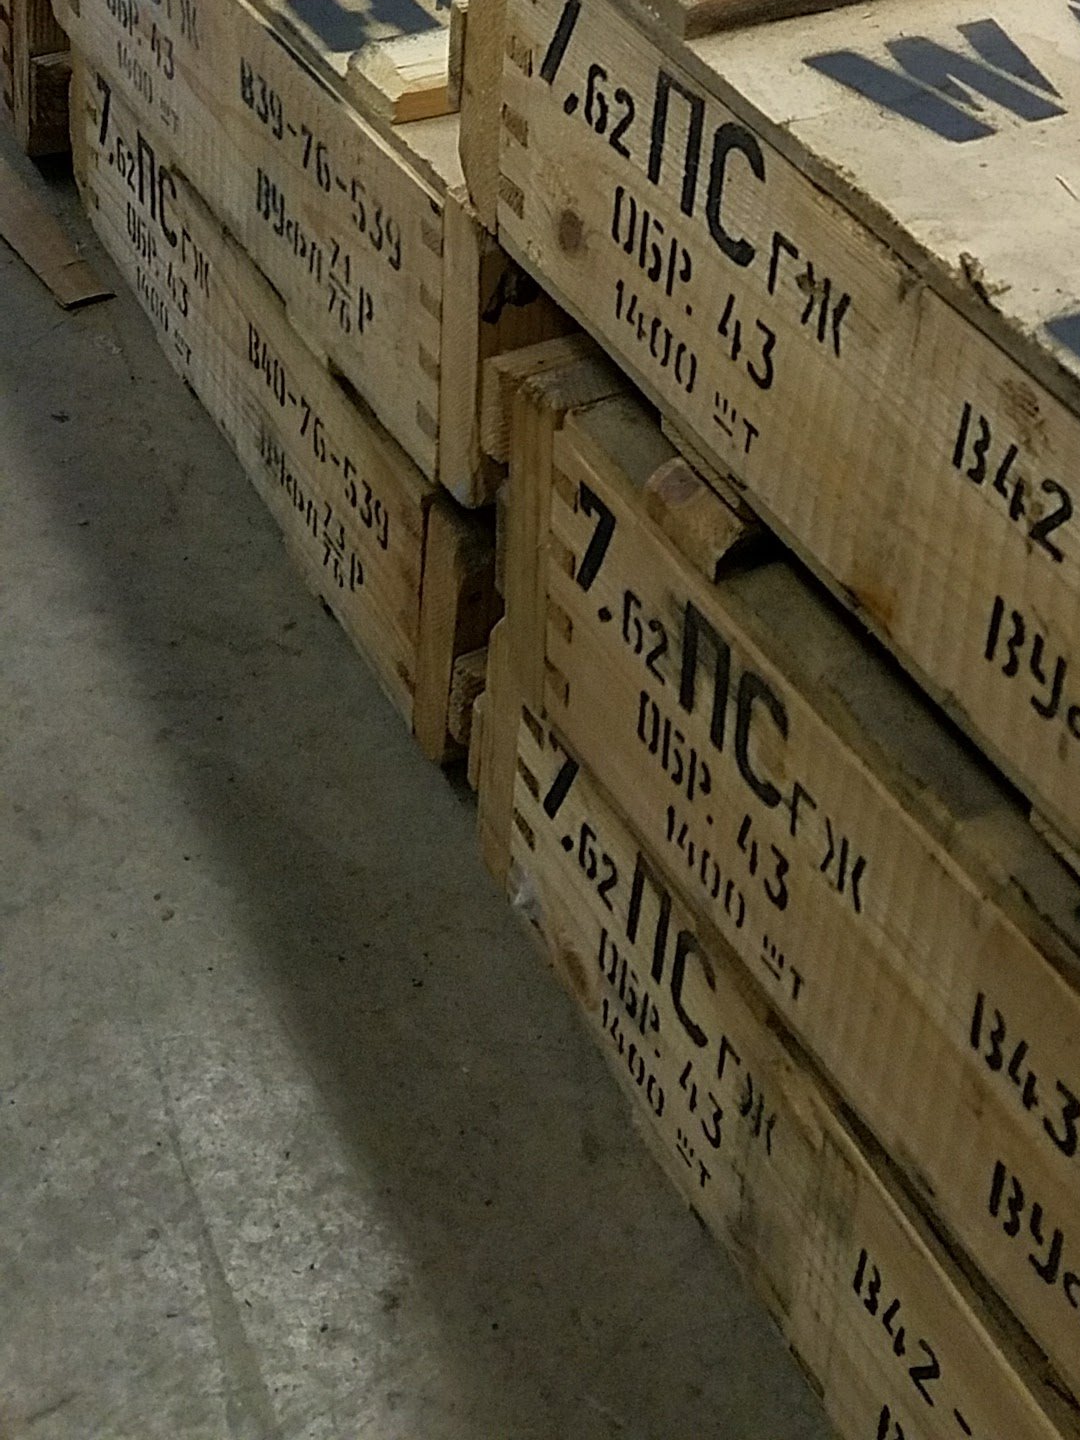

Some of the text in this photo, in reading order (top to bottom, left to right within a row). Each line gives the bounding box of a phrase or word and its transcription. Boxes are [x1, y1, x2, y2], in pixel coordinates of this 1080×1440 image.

[614, 279, 697, 394] 1400
[716, 293, 776, 390] 43
[666, 806, 746, 928] 1400
[737, 814, 790, 911] 43
[680, 1061, 723, 1148] 43
